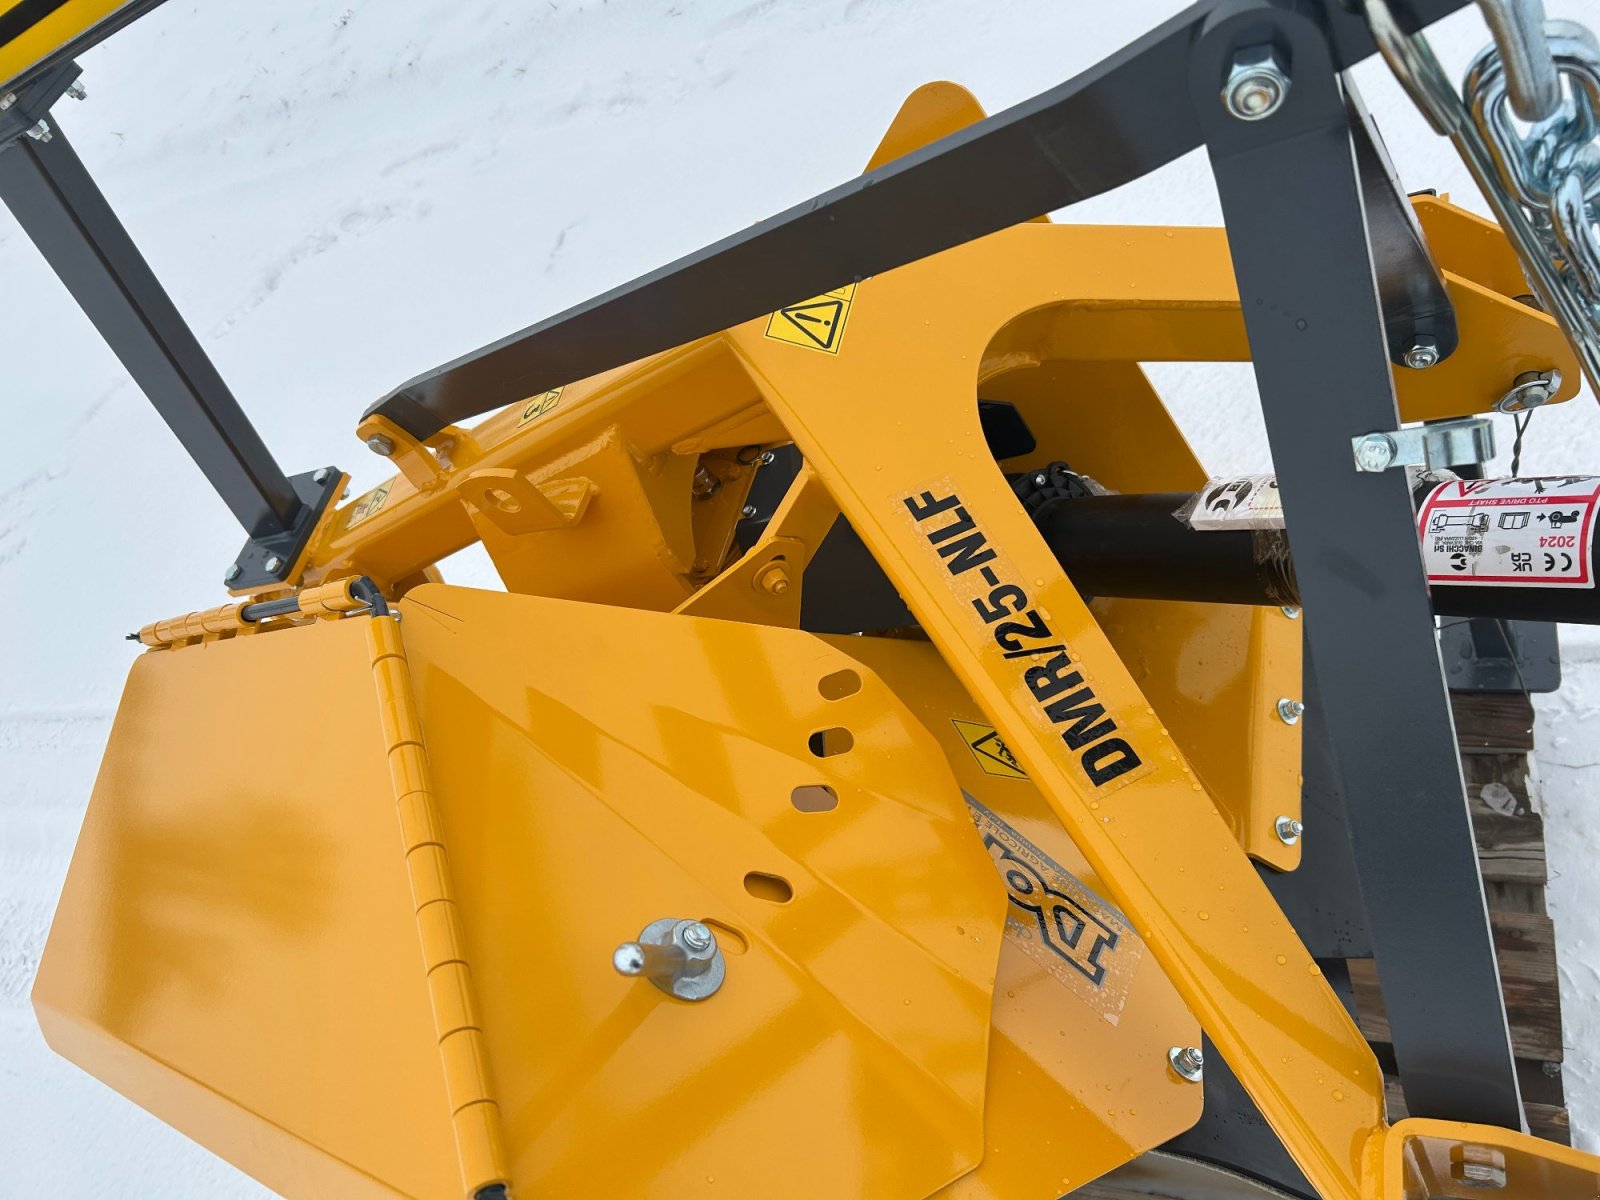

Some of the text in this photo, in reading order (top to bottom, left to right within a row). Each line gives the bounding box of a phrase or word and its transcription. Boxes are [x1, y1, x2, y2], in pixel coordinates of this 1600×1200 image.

[1539, 535, 1576, 548] 2024
[1434, 544, 1483, 553] BINACCHI Srl
[1511, 552, 1532, 562] CA
[1543, 552, 1573, 572] CE
[1512, 562, 1533, 572] UK
[903, 490, 1143, 787] DMR/25-NLF
[985, 821, 1050, 872] AGRICOLE
